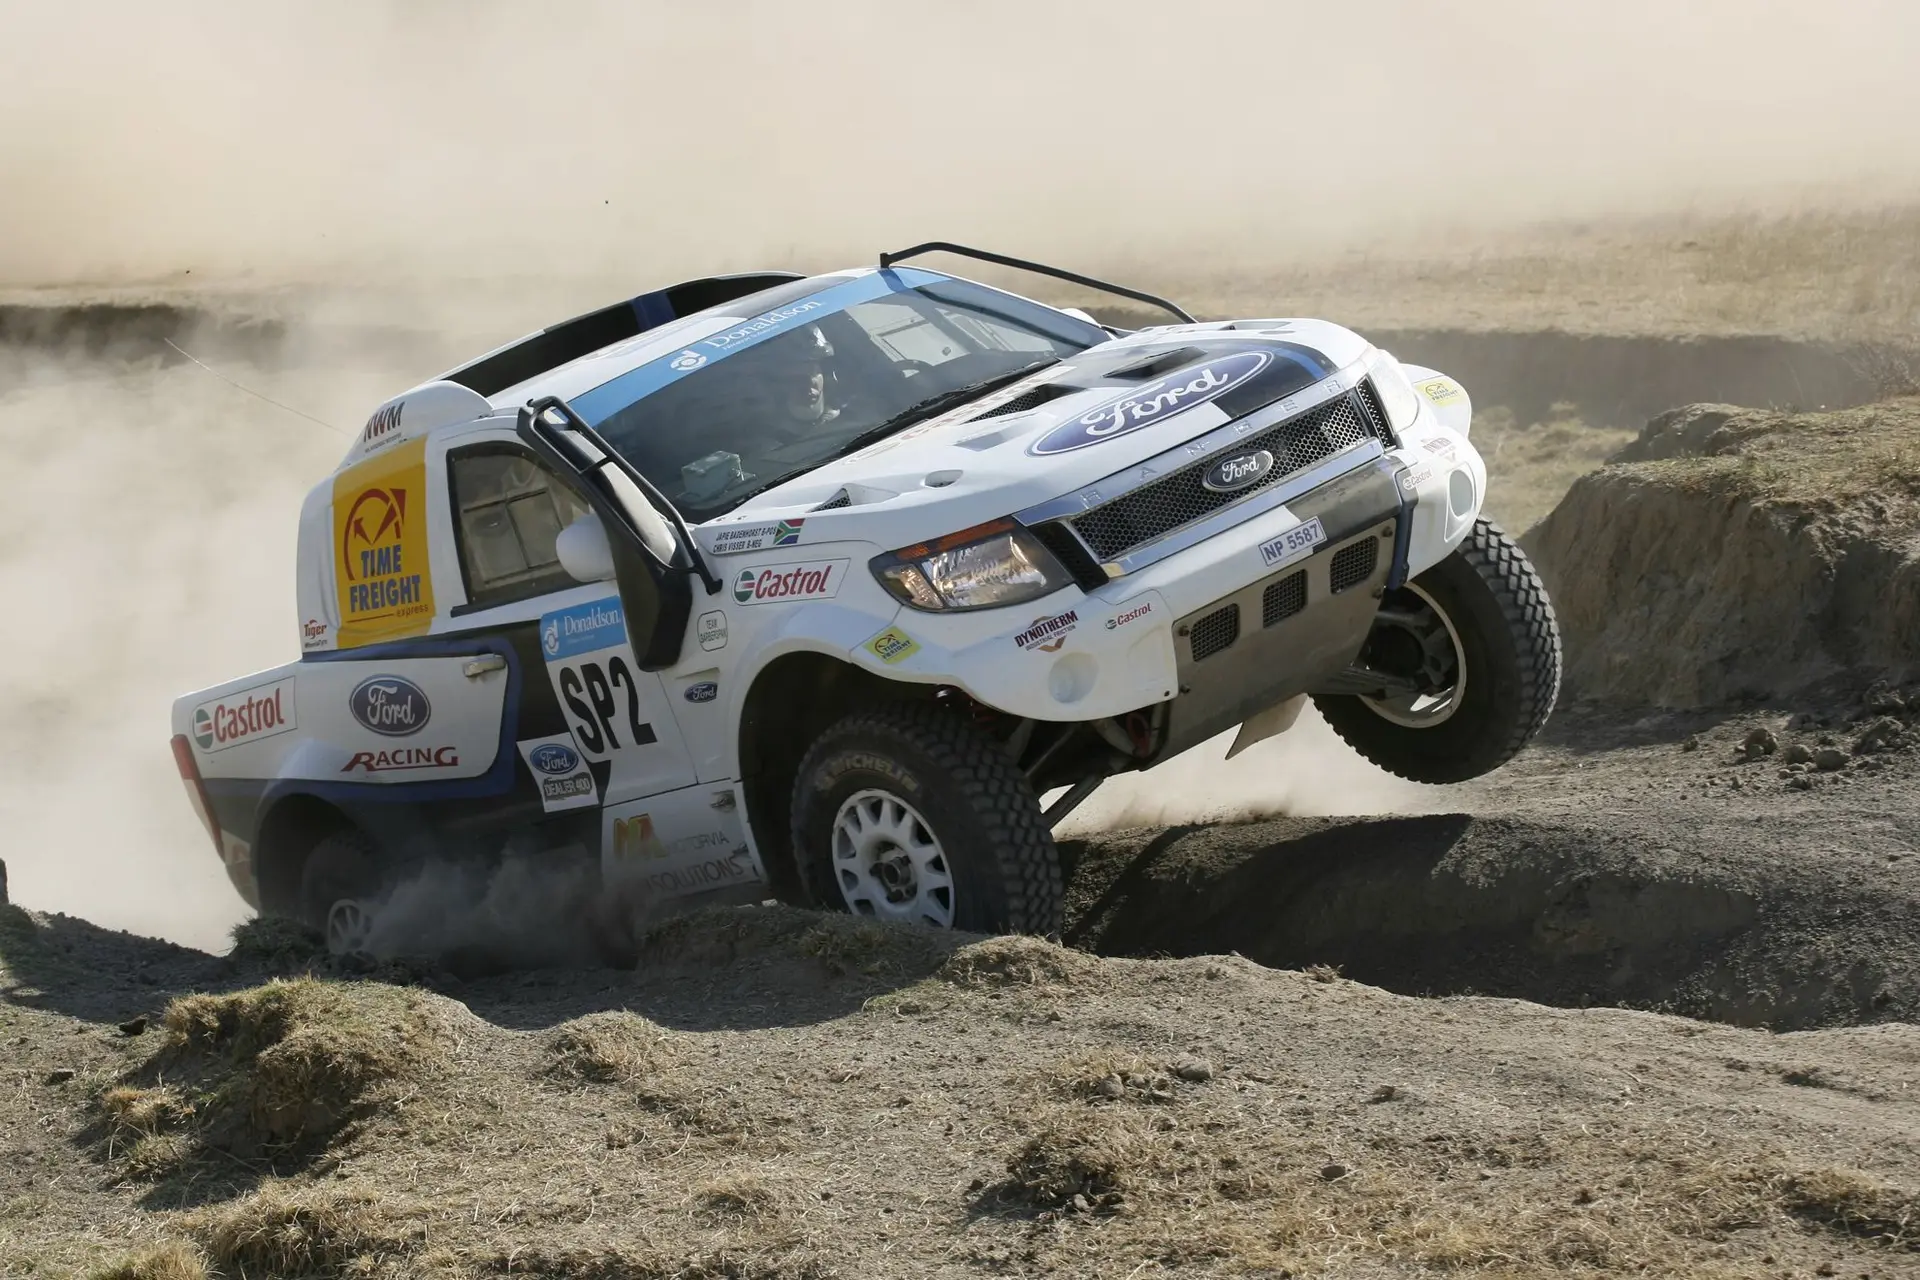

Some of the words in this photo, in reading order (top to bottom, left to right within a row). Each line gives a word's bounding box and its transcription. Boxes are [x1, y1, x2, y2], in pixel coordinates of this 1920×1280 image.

[704, 301, 822, 348] Donaldson
[1080, 369, 1230, 436] Ford
[1221, 453, 1260, 484] Ford
[1411, 468, 1433, 486] Castrol
[713, 543, 728, 553] CHRIS
[728, 540, 746, 551] VISSER
[1264, 542, 1286, 562] NP
[1286, 524, 1321, 551] 5587
[361, 545, 402, 578] TIME
[350, 575, 420, 612] FREIGHT
[755, 565, 832, 598] Castrol
[396, 604, 429, 618] express
[564, 607, 620, 636] Donaldson
[1116, 603, 1152, 627] Castrol
[304, 623, 327, 640] Tiger
[1014, 610, 1079, 648] DYNOTHERM
[367, 685, 416, 726] Ford
[559, 656, 658, 754] SP2
[692, 682, 716, 701] Ford
[214, 688, 285, 743] Castrol
[340, 746, 459, 772] RACING
[541, 749, 571, 771] Ford
[544, 779, 576, 797] DEALER
[575, 777, 591, 791] 400
[649, 856, 745, 891] SOLUTIONS
